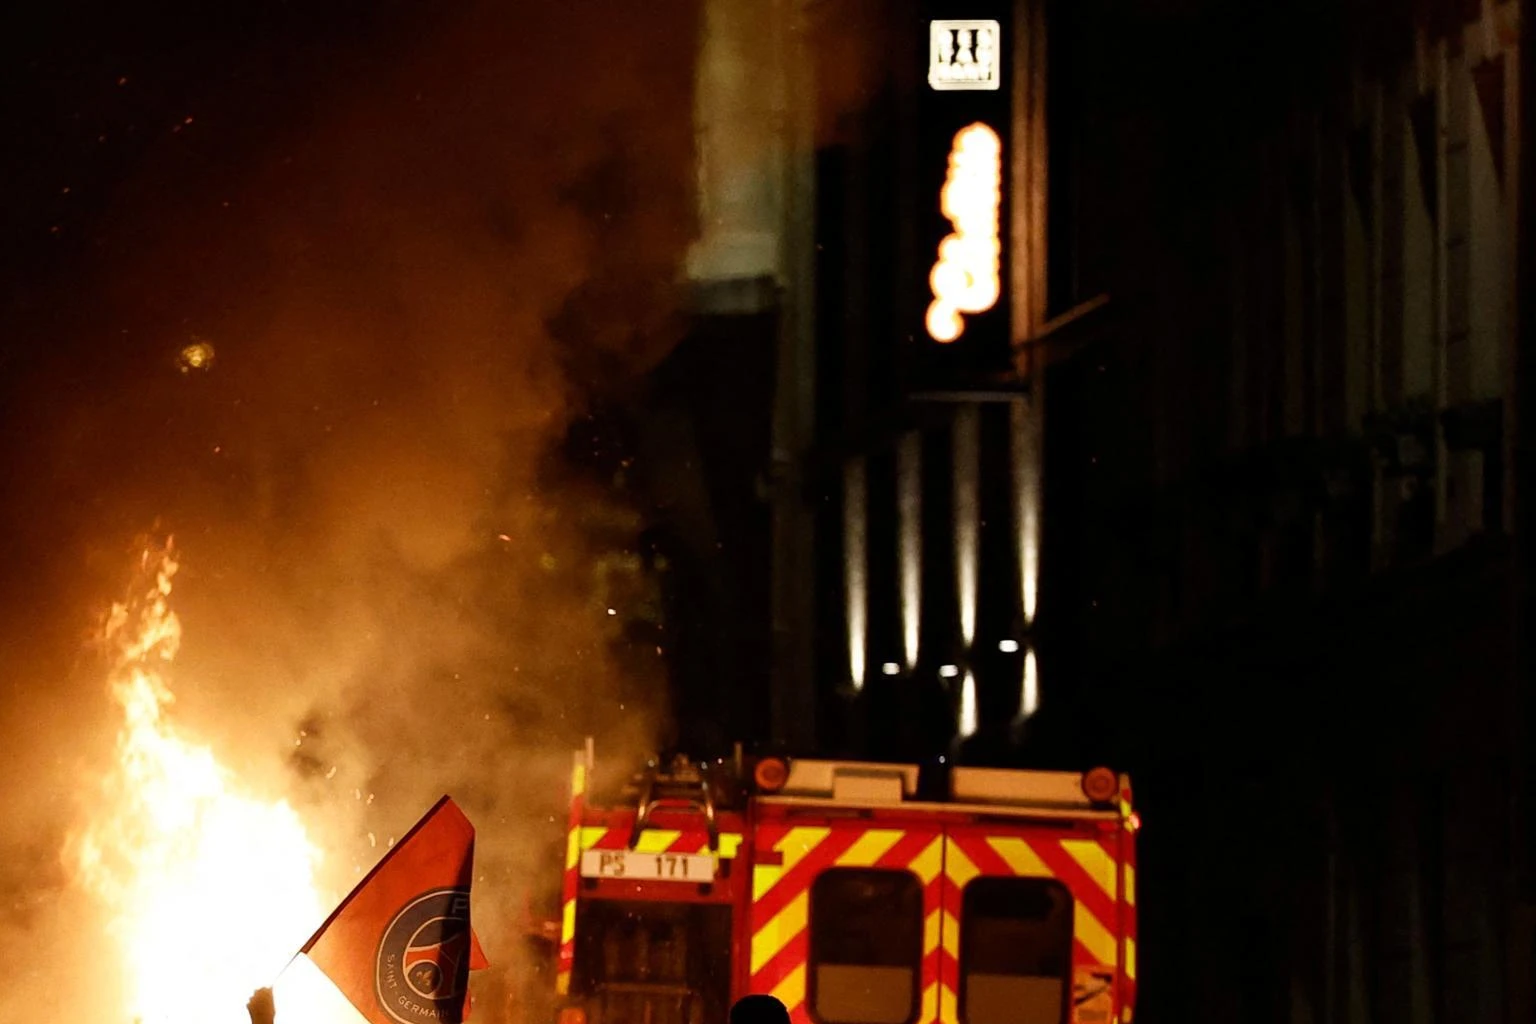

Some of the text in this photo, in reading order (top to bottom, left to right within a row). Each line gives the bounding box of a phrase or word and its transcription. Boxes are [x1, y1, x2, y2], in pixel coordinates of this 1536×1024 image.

[599, 853, 689, 876] PS 171
[386, 953, 399, 989] SAINT
